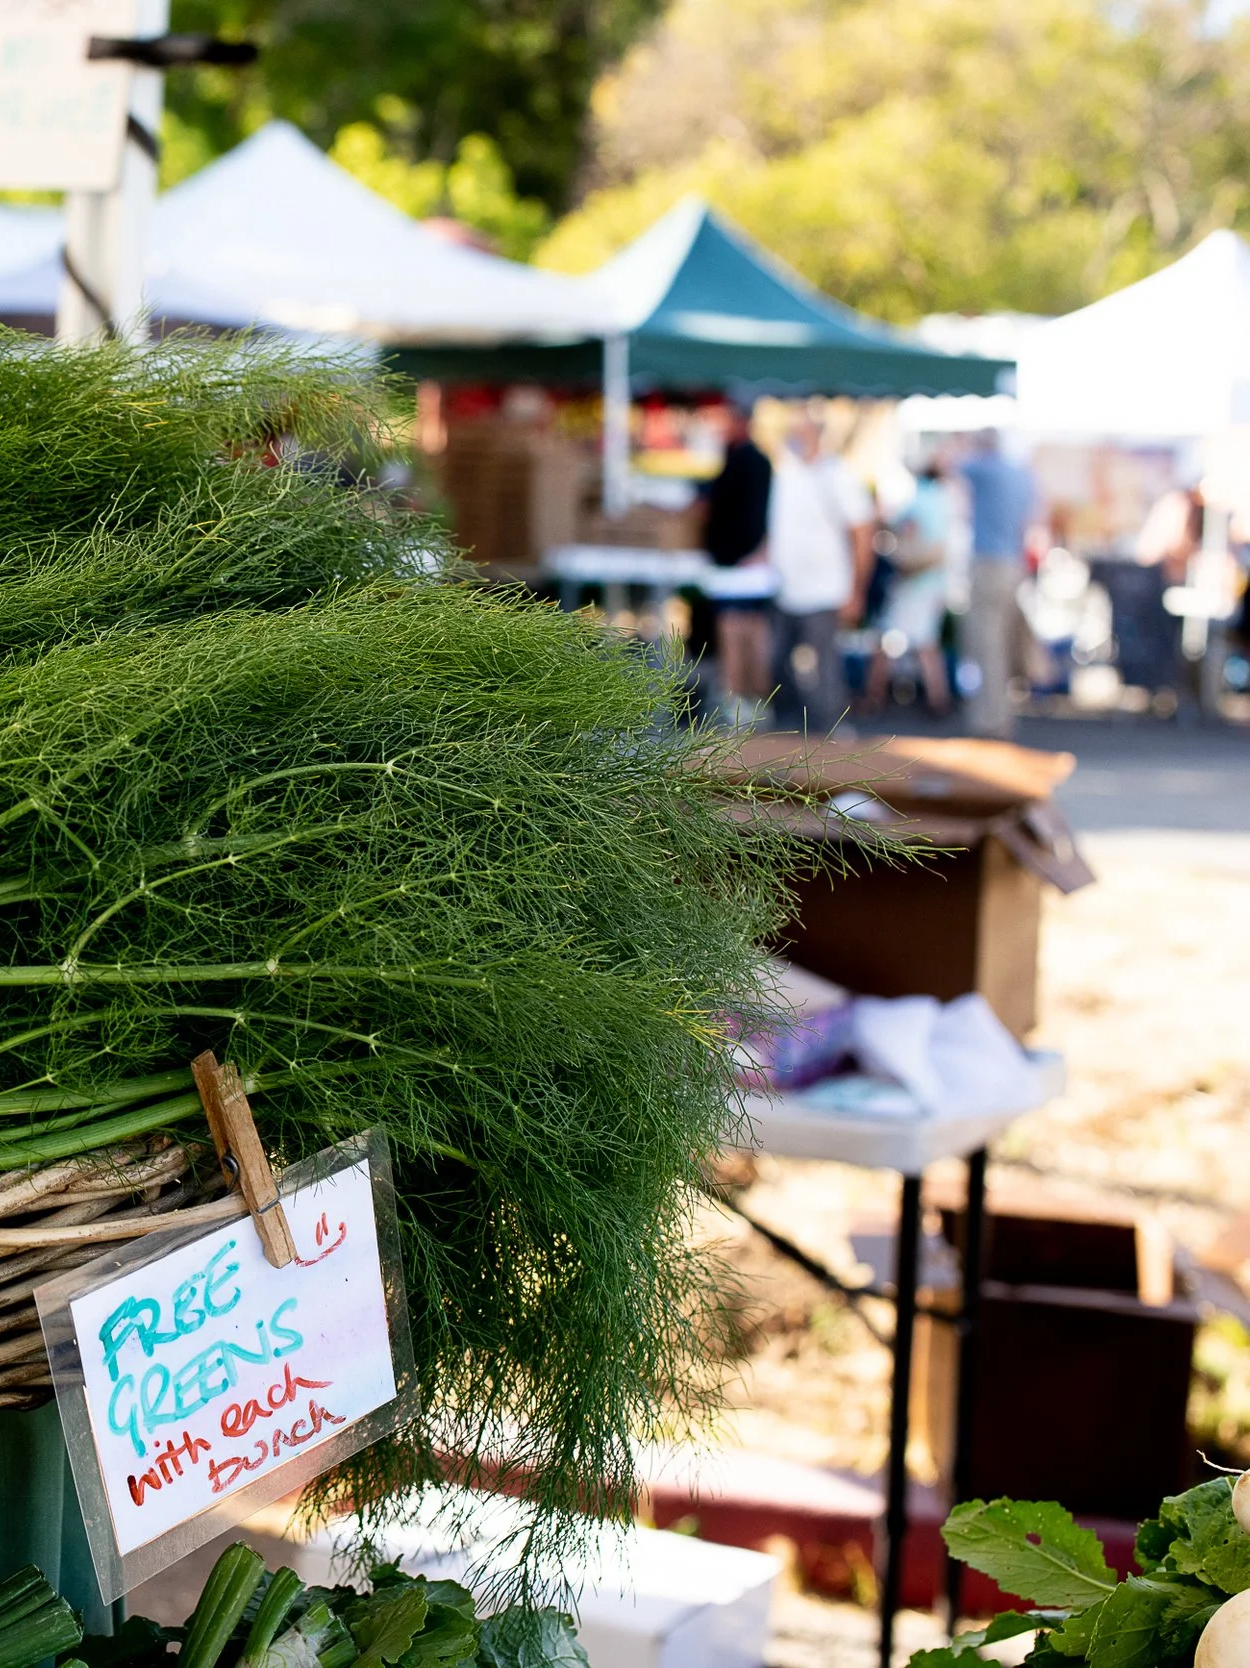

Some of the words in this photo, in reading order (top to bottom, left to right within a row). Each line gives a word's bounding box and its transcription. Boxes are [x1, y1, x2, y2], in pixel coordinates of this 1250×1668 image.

[98, 1239, 242, 1382] FREE
[107, 1297, 304, 1458] GREENS
[126, 1430, 211, 1506] with
[220, 1362, 334, 1437] each
[207, 1400, 346, 1494] bunch
